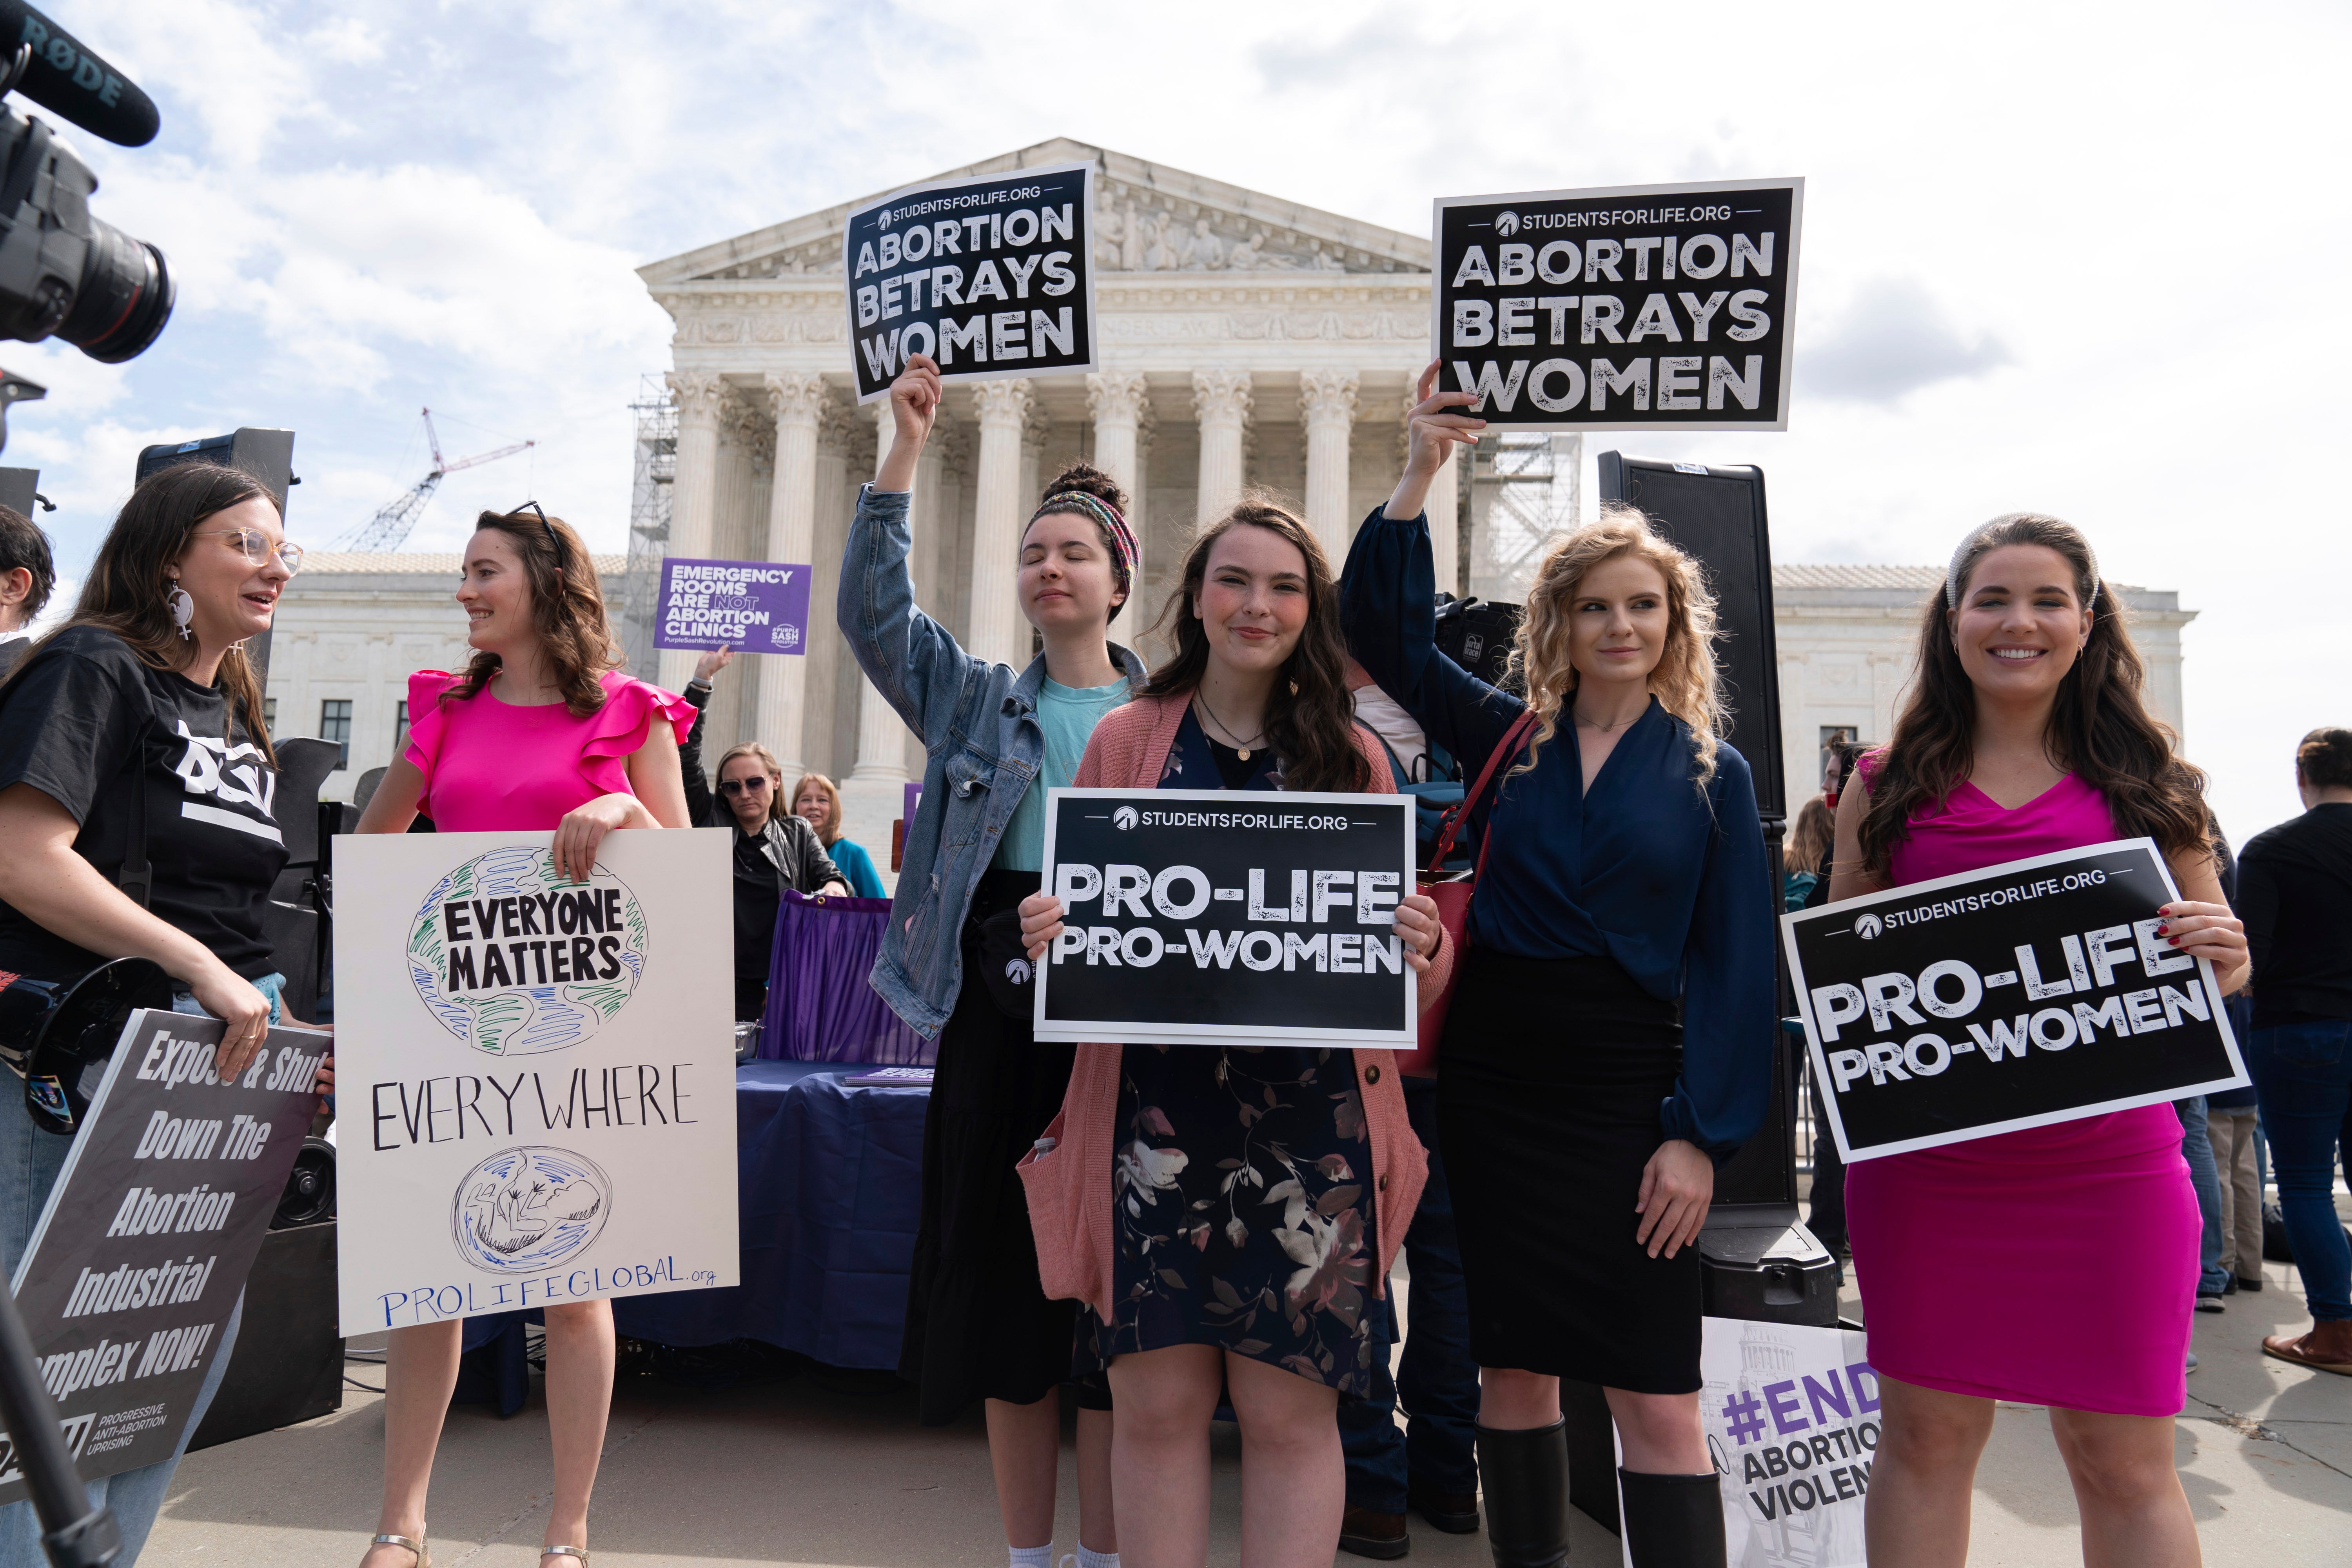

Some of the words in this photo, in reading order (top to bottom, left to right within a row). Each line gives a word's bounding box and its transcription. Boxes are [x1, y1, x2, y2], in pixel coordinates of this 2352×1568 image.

[20, 15, 123, 108] RØDE
[893, 186, 1040, 221] STUDENTSFORLIFE.ORG
[1523, 205, 1731, 230] STUDENTSFORLIFE.ORG
[855, 203, 1073, 279] ABORTION
[1452, 232, 1775, 287] ABORTION
[857, 251, 1076, 328] BETRAYS
[861, 307, 1074, 382] WOMEN
[1453, 289, 1771, 347] BETRAYS
[1452, 355, 1763, 413] WOMEN
[668, 593, 710, 608] ARE
[714, 595, 759, 611] NOT
[670, 579, 747, 596] ROOMS
[672, 565, 793, 584] EMERGENCY
[664, 636, 744, 646] PurpleSashRevolution.com
[665, 621, 746, 639] CLINICS
[666, 607, 769, 625] ABORTION
[771, 632, 799, 640] SASH
[1464, 648, 1479, 657] brace
[1142, 811, 1348, 830] STUDENTSFORLIFE.ORG
[443, 888, 624, 942] EVERYONE
[1056, 863, 1400, 924] PRO-LIFE
[1884, 869, 2106, 929] STUDENTSFORLIFE.ORG
[0, 970, 21, 980] EAL
[448, 936, 622, 992] MATTERS
[1052, 926, 1402, 974] PRO-WOMEN
[1811, 916, 2194, 1043] PRO-LIFE
[1828, 979, 2211, 1093] PRO-WOMEN
[243, 1048, 269, 1089] &
[372, 1063, 699, 1151] EVERYWHERE
[134, 1110, 223, 1160] Down
[220, 1114, 272, 1160] The
[106, 1183, 236, 1238] Abortion
[62, 1256, 217, 1319] Industrial
[377, 1256, 716, 1327] PROLIFEGLOBAL.org
[34, 1339, 141, 1402] mplex
[134, 1323, 216, 1379] NOW!
[92, 1415, 167, 1442] ANTI-ABORTION
[99, 1403, 165, 1427] PROGRESSIVE
[1722, 1362, 1881, 1446] #END
[87, 1435, 134, 1455] UPRISING
[1744, 1419, 1881, 1485] ABORTIO
[1749, 1461, 1871, 1521] VIOLEN
